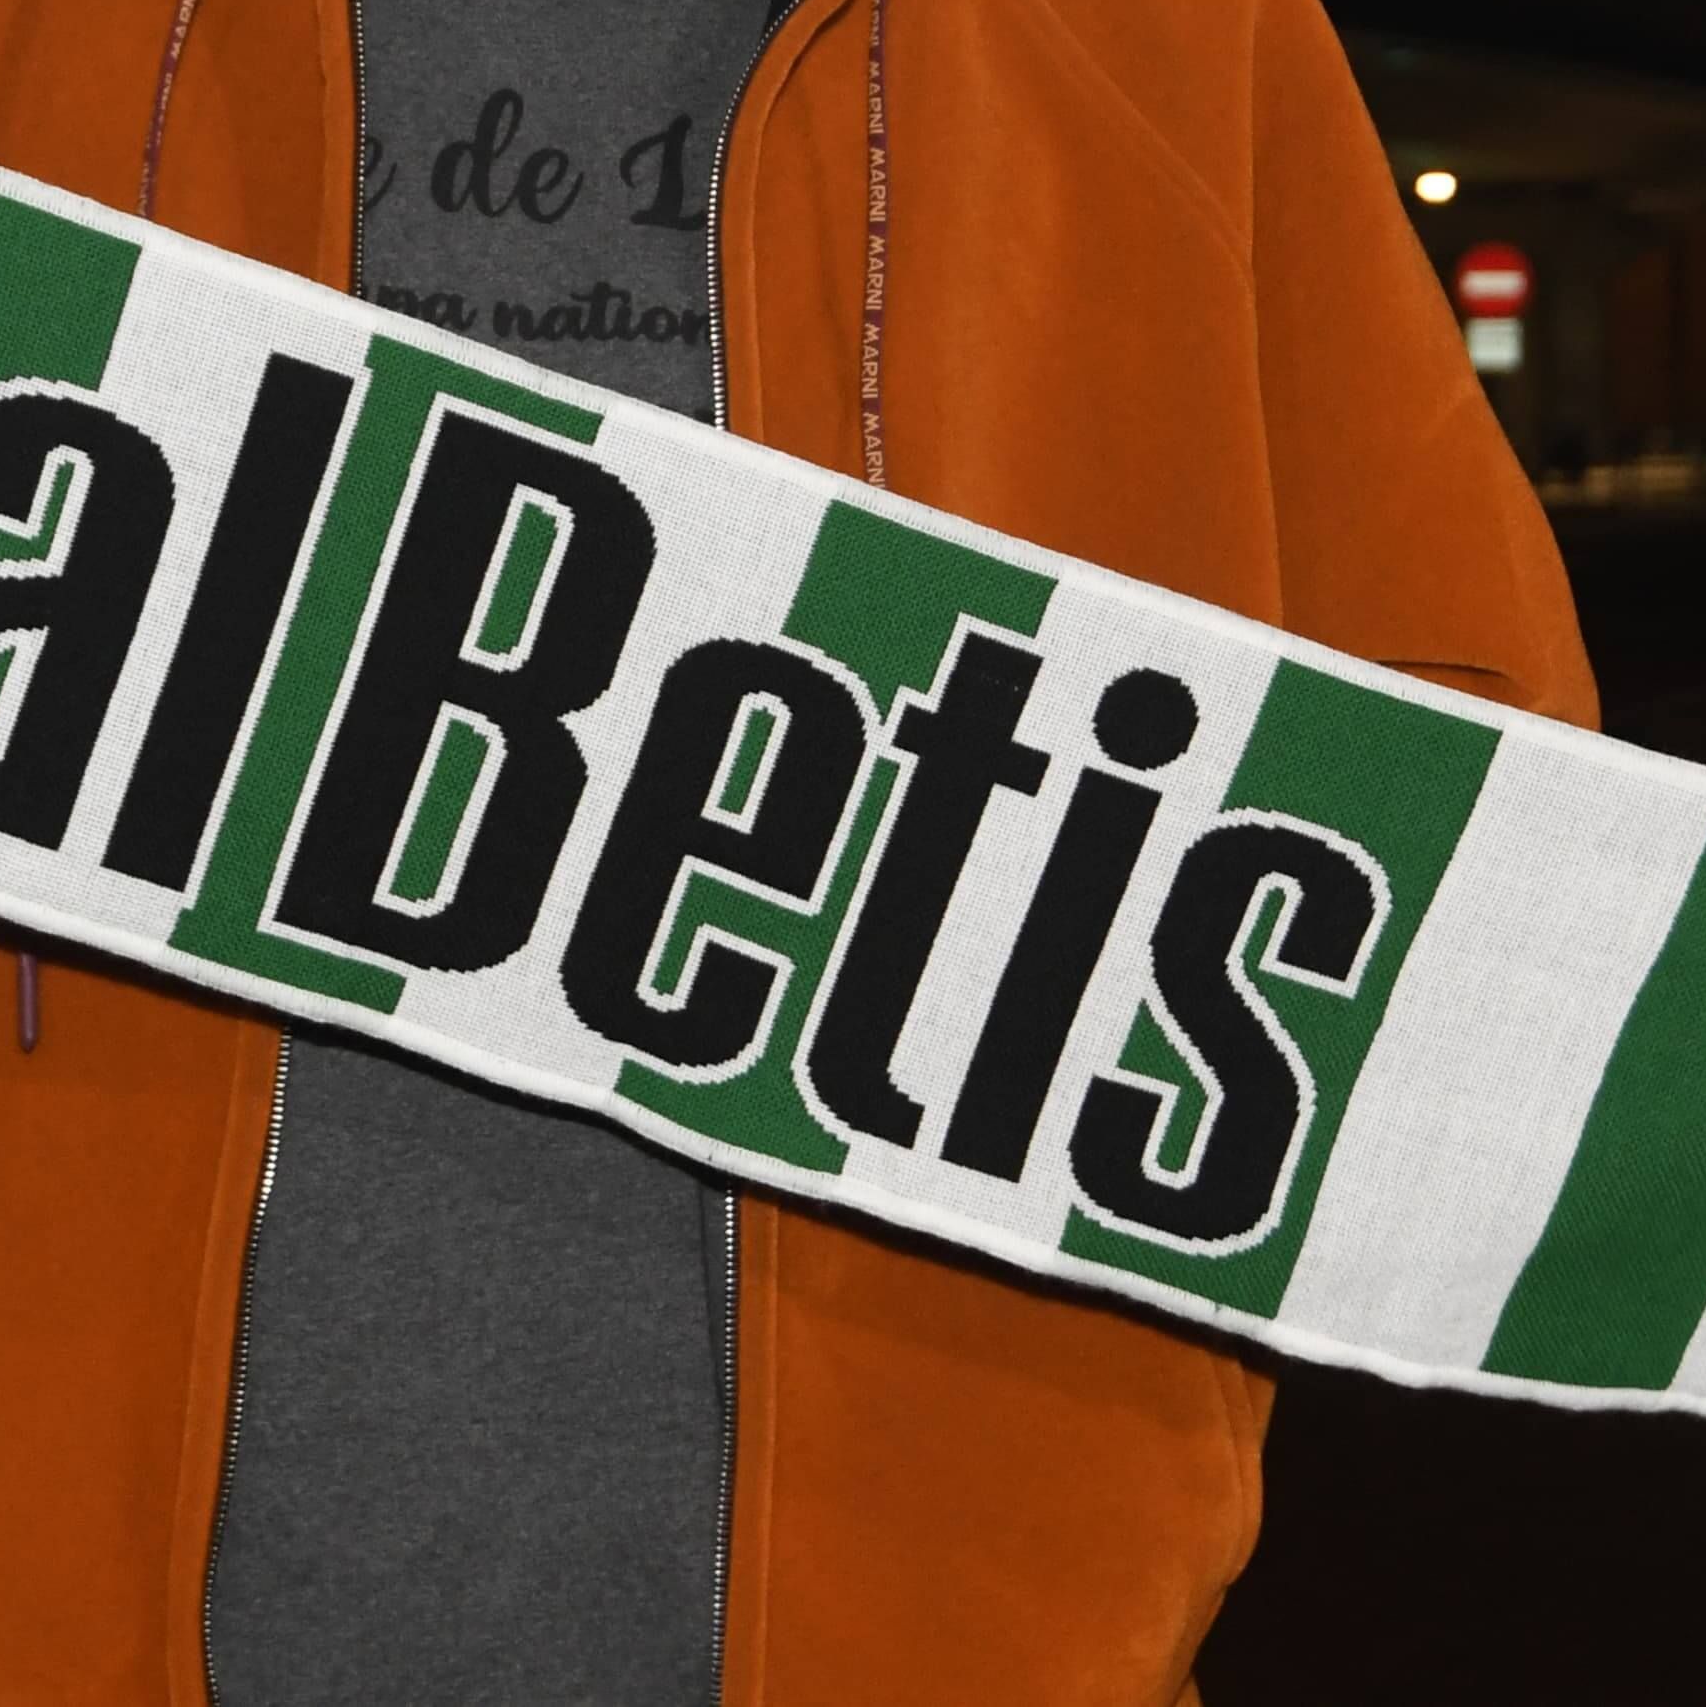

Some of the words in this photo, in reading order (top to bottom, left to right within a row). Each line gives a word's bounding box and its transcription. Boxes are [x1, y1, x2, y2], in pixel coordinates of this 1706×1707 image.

[430, 88, 584, 224] de
[868, 146, 887, 224] MARNI
[864, 234, 883, 312] MARNI
[861, 322, 879, 400] MARNI
[863, 410, 887, 489] MARNI
